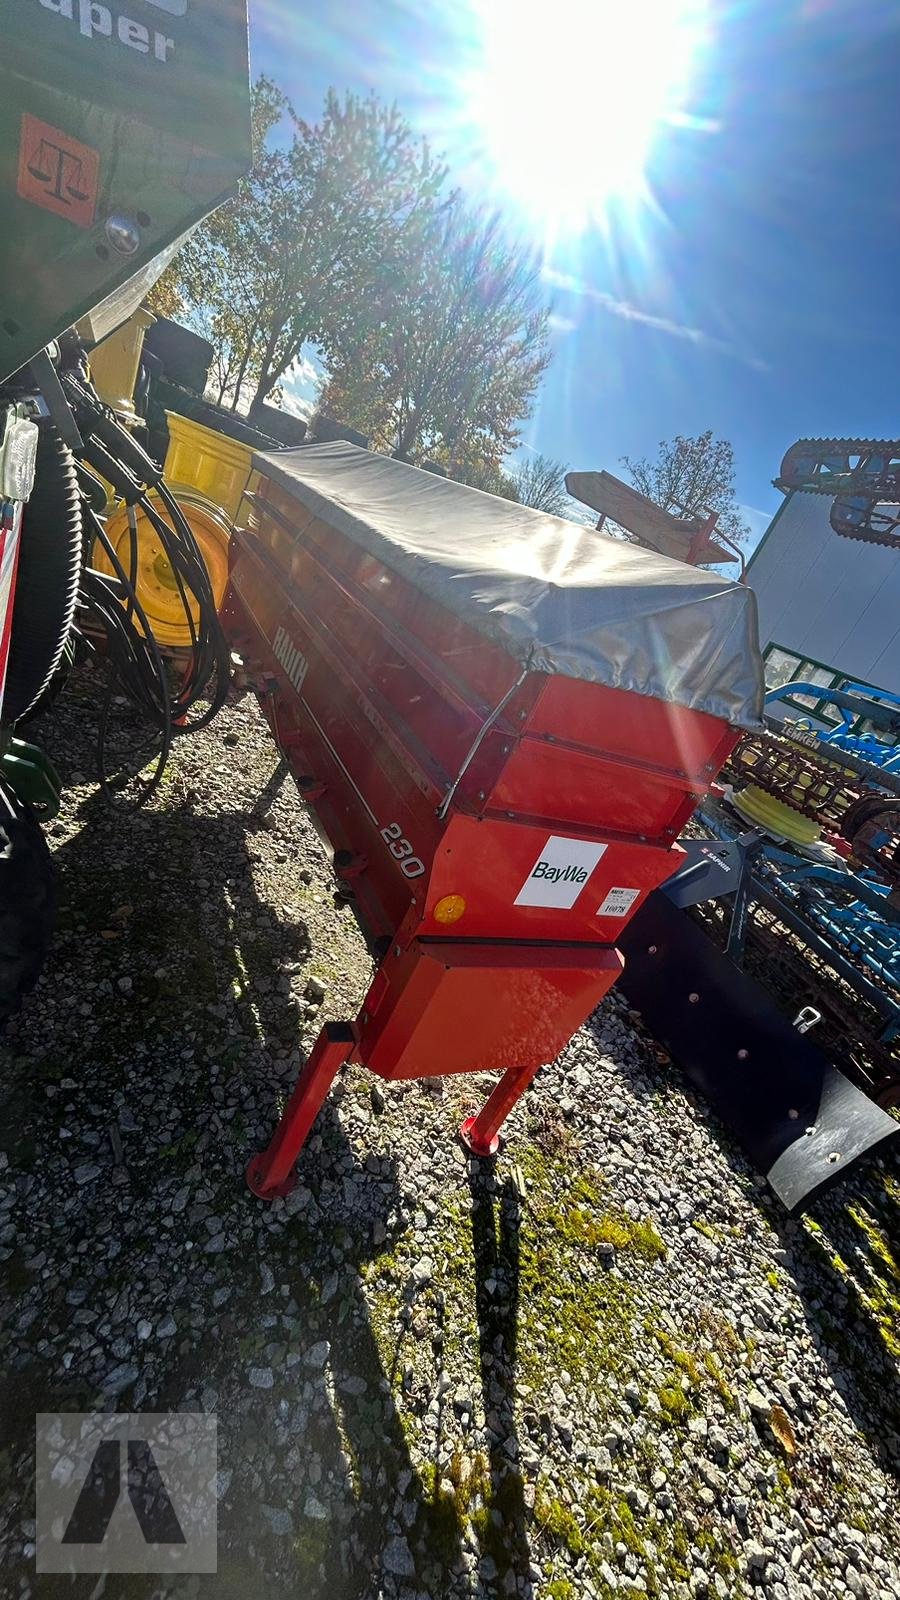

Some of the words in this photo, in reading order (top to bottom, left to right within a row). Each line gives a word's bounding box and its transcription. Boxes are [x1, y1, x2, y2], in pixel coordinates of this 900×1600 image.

[272, 625, 309, 694] RAUCH
[380, 822, 426, 878] 230
[707, 852, 731, 873] SAPHIR
[531, 861, 588, 883] BayWa
